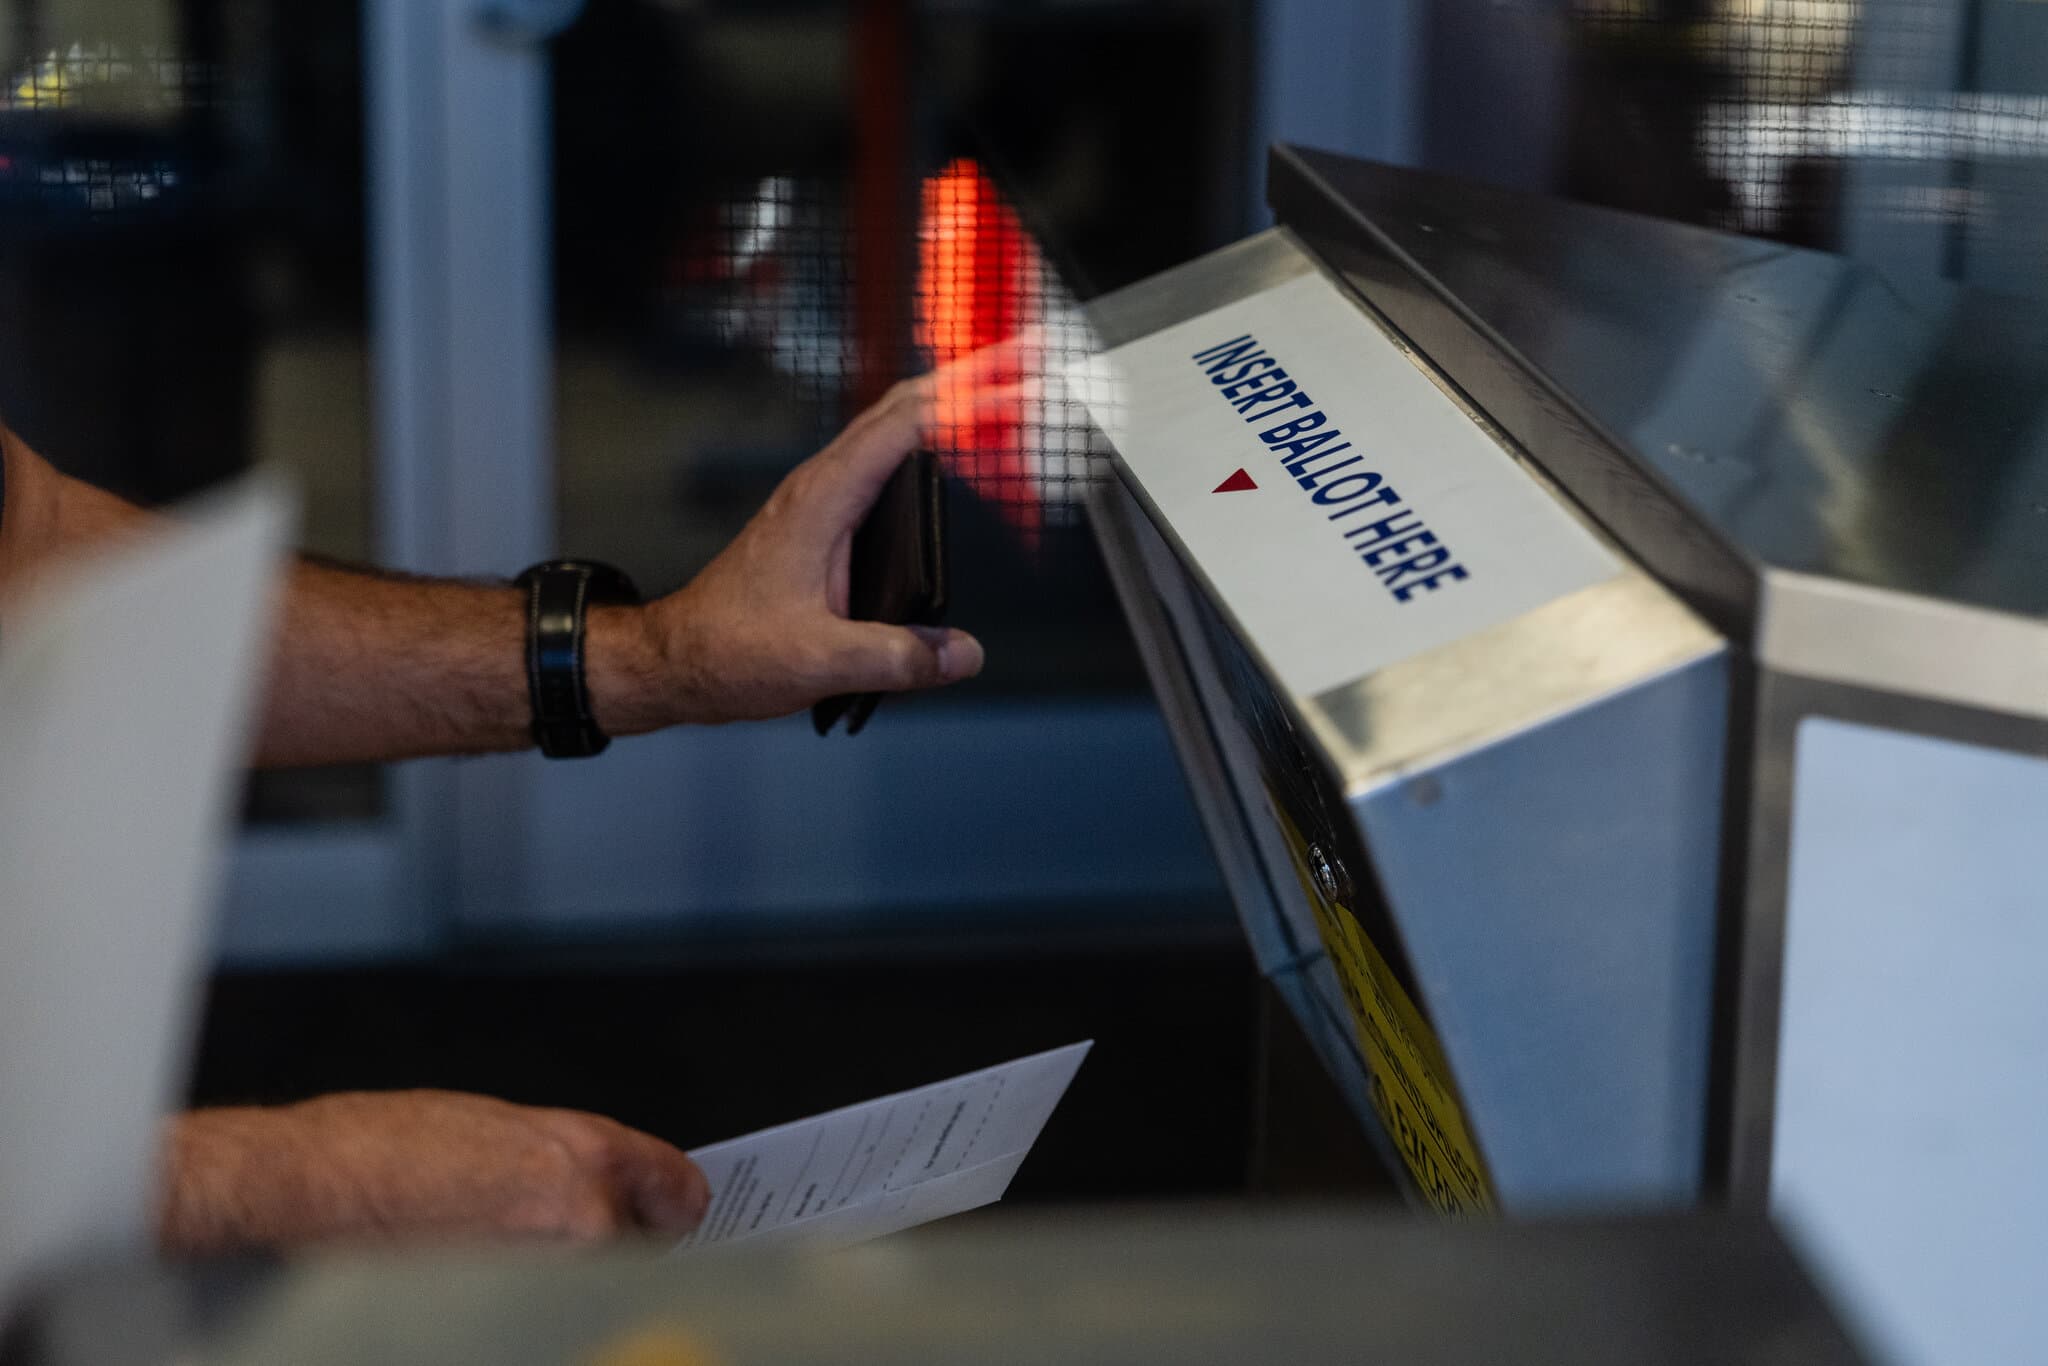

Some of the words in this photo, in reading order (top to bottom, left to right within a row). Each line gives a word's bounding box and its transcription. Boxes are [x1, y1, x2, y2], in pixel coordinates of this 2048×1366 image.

[1192, 334, 1314, 423] INSERT
[1258, 410, 1402, 521] BALLOT
[1343, 509, 1471, 604] HERE
